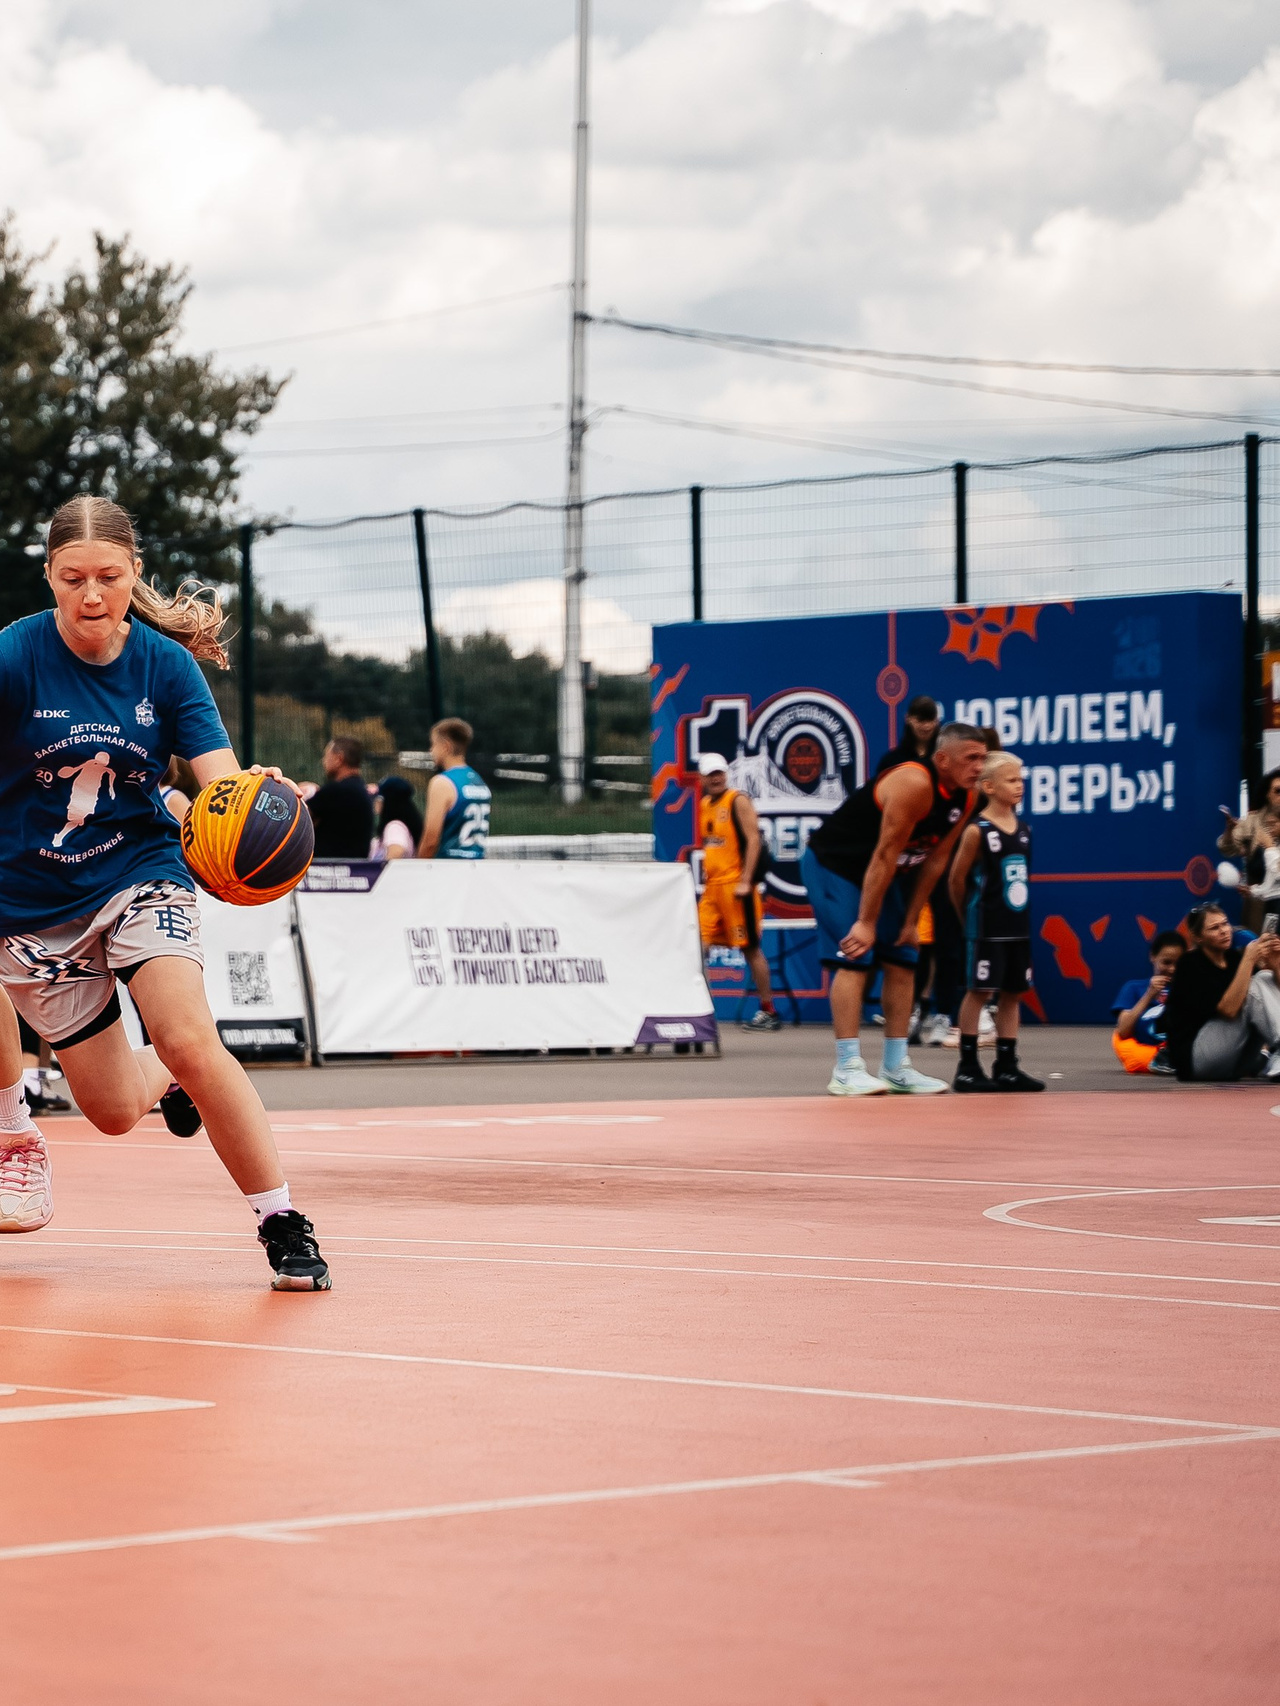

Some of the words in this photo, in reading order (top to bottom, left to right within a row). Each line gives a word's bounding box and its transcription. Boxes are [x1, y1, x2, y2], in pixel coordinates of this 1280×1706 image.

[43, 709, 71, 719] DKC
[955, 689, 1176, 748] ЮБИЛЕЕМ,
[70, 723, 120, 735] ДЕТСКАЯ
[34, 734, 125, 759] БАСКЕТБОЛЬНАЯ
[126, 742, 148, 759] ЛИГА
[36, 769, 53, 783] 20
[127, 770, 147, 783] 24
[39, 832, 124, 863] ВЕРХНЕВОЛЖЬЕ
[446, 922, 514, 954] ТВЕРСКОЙ
[516, 927, 559, 954] ЦЕНТР
[452, 957, 520, 984] УЛИЧНОГО
[523, 957, 608, 984] БАСКЕТБОЛА
